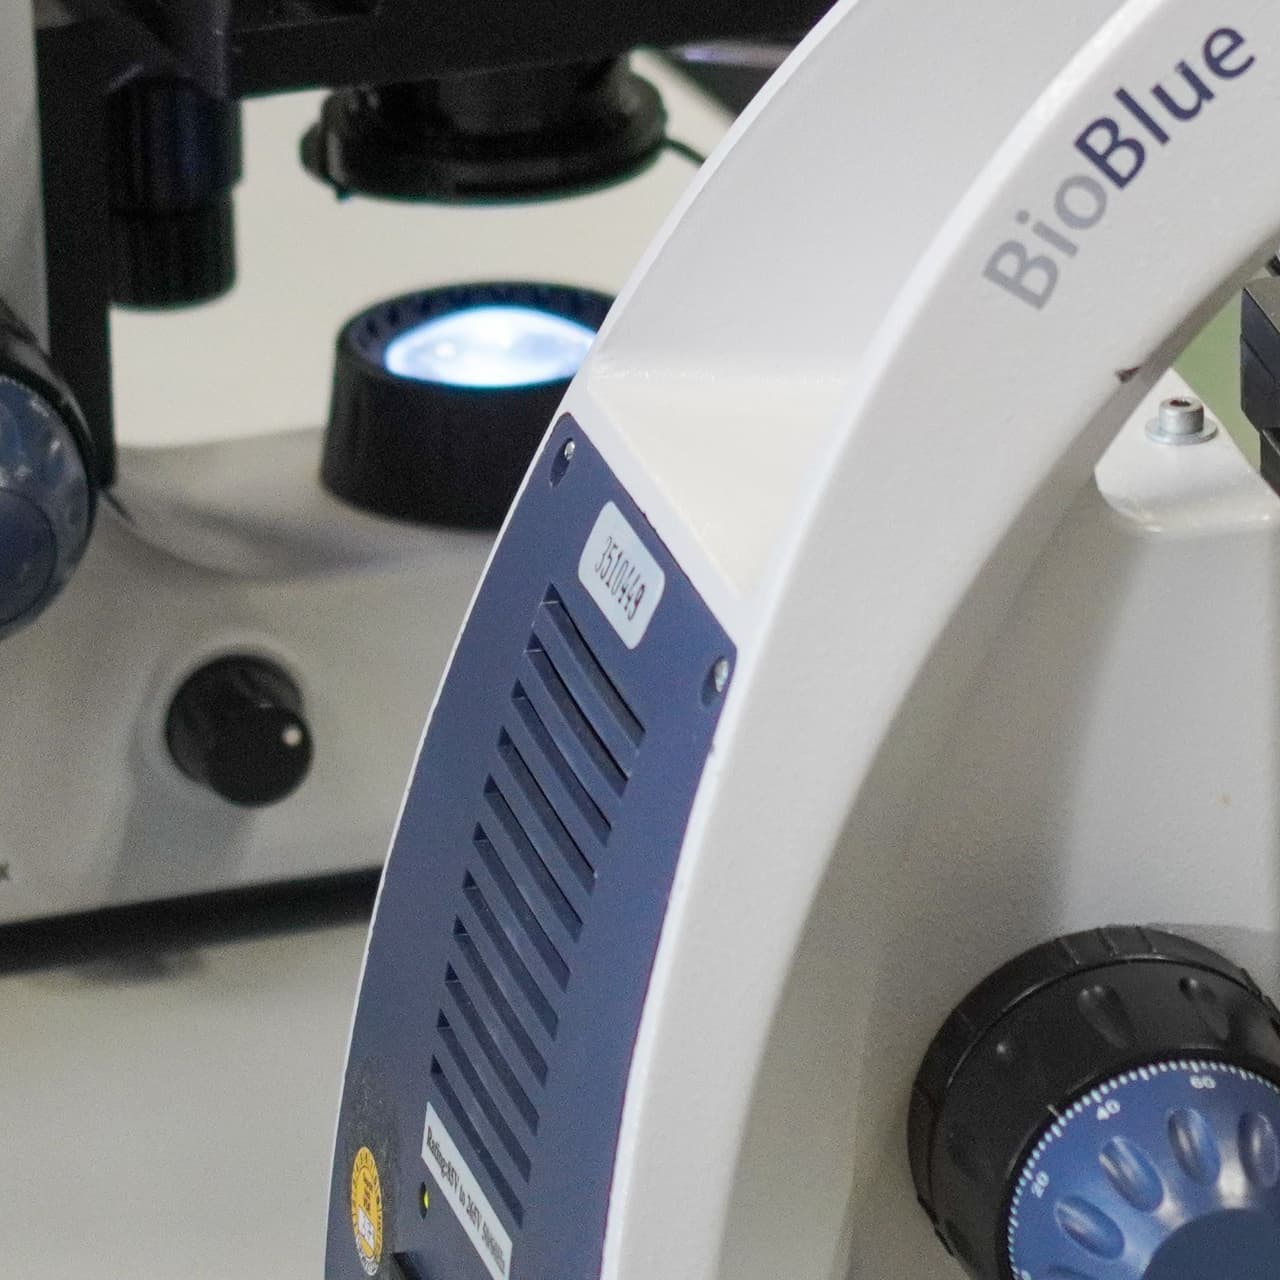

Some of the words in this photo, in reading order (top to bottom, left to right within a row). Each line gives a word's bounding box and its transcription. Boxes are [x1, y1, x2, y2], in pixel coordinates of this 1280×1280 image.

[981, 27, 1256, 311] BioBlue
[1189, 1075, 1217, 1089] 60
[1096, 1098, 1121, 1121] 40
[1030, 1170, 1050, 1198] 20
